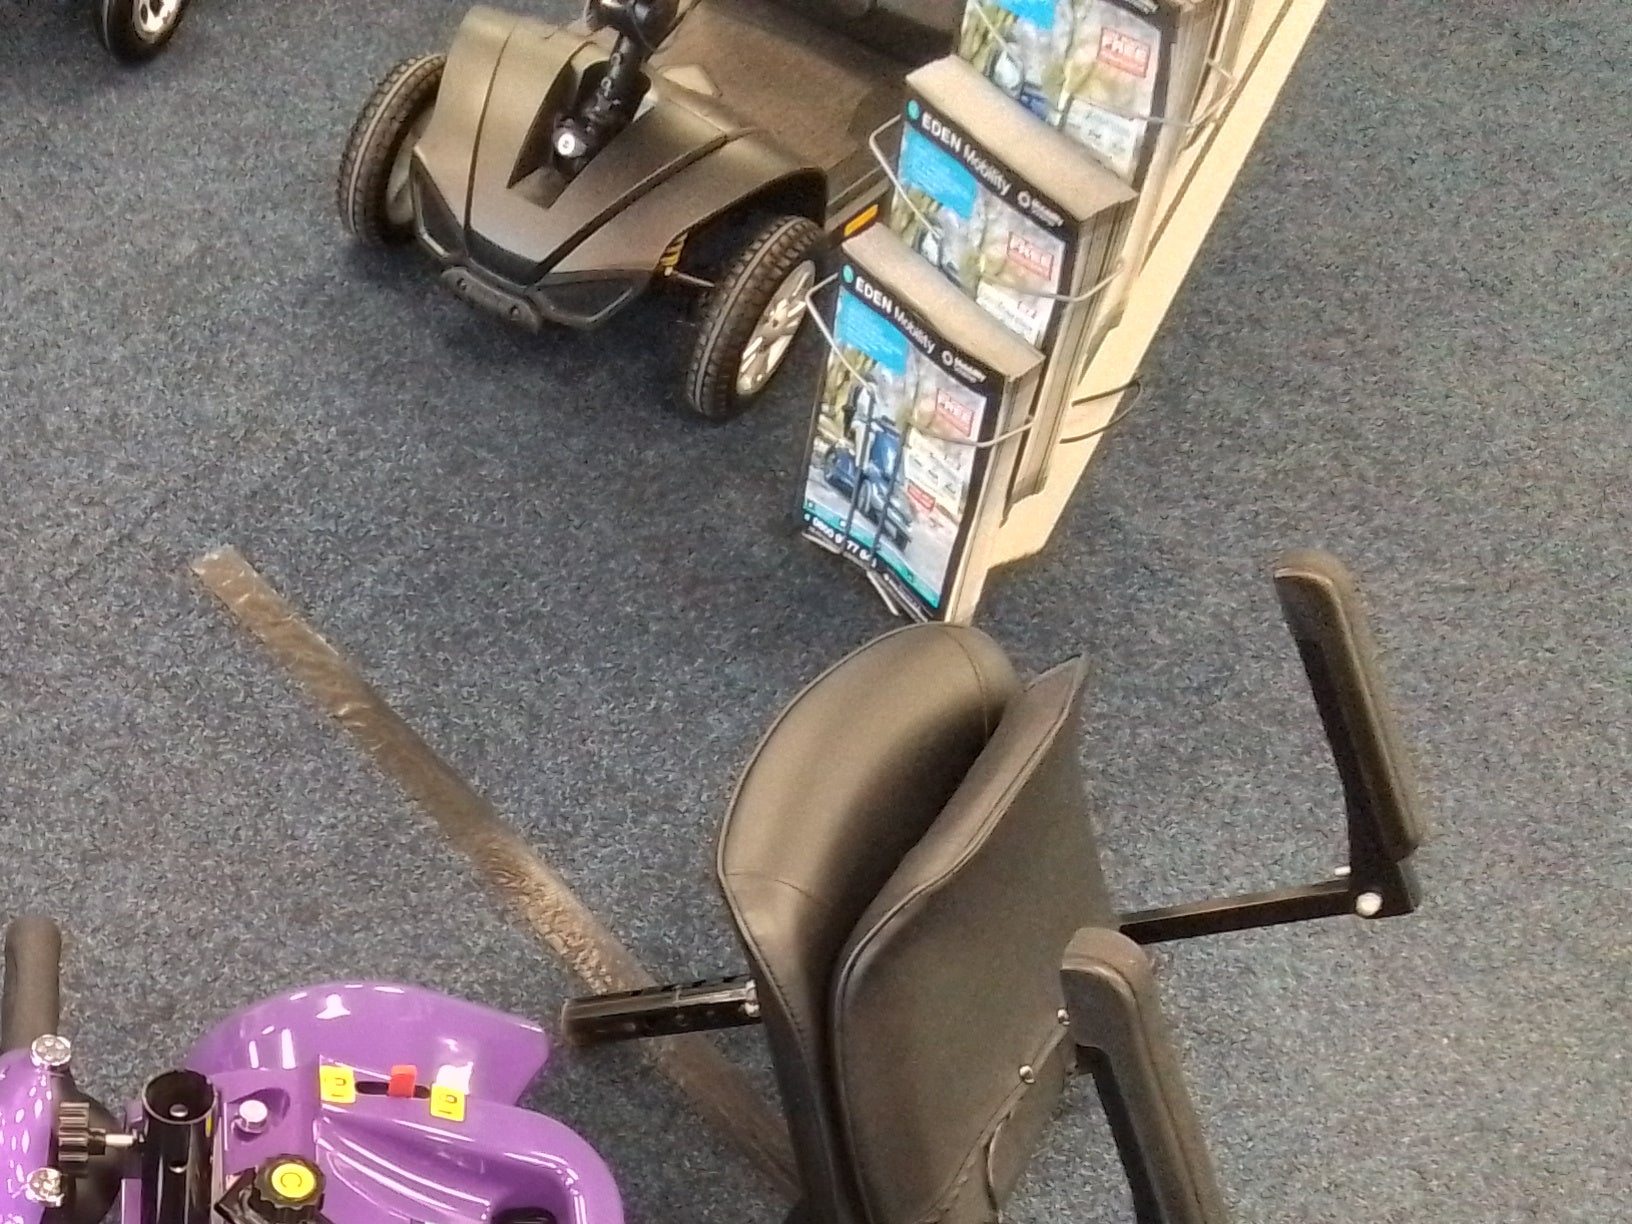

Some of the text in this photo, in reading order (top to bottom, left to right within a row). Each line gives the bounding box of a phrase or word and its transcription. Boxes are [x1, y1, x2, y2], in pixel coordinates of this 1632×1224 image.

[921, 111, 962, 153] EDEN
[963, 144, 1012, 196] Mobility
[854, 276, 893, 314] EDEN
[894, 306, 937, 355] Mobility
